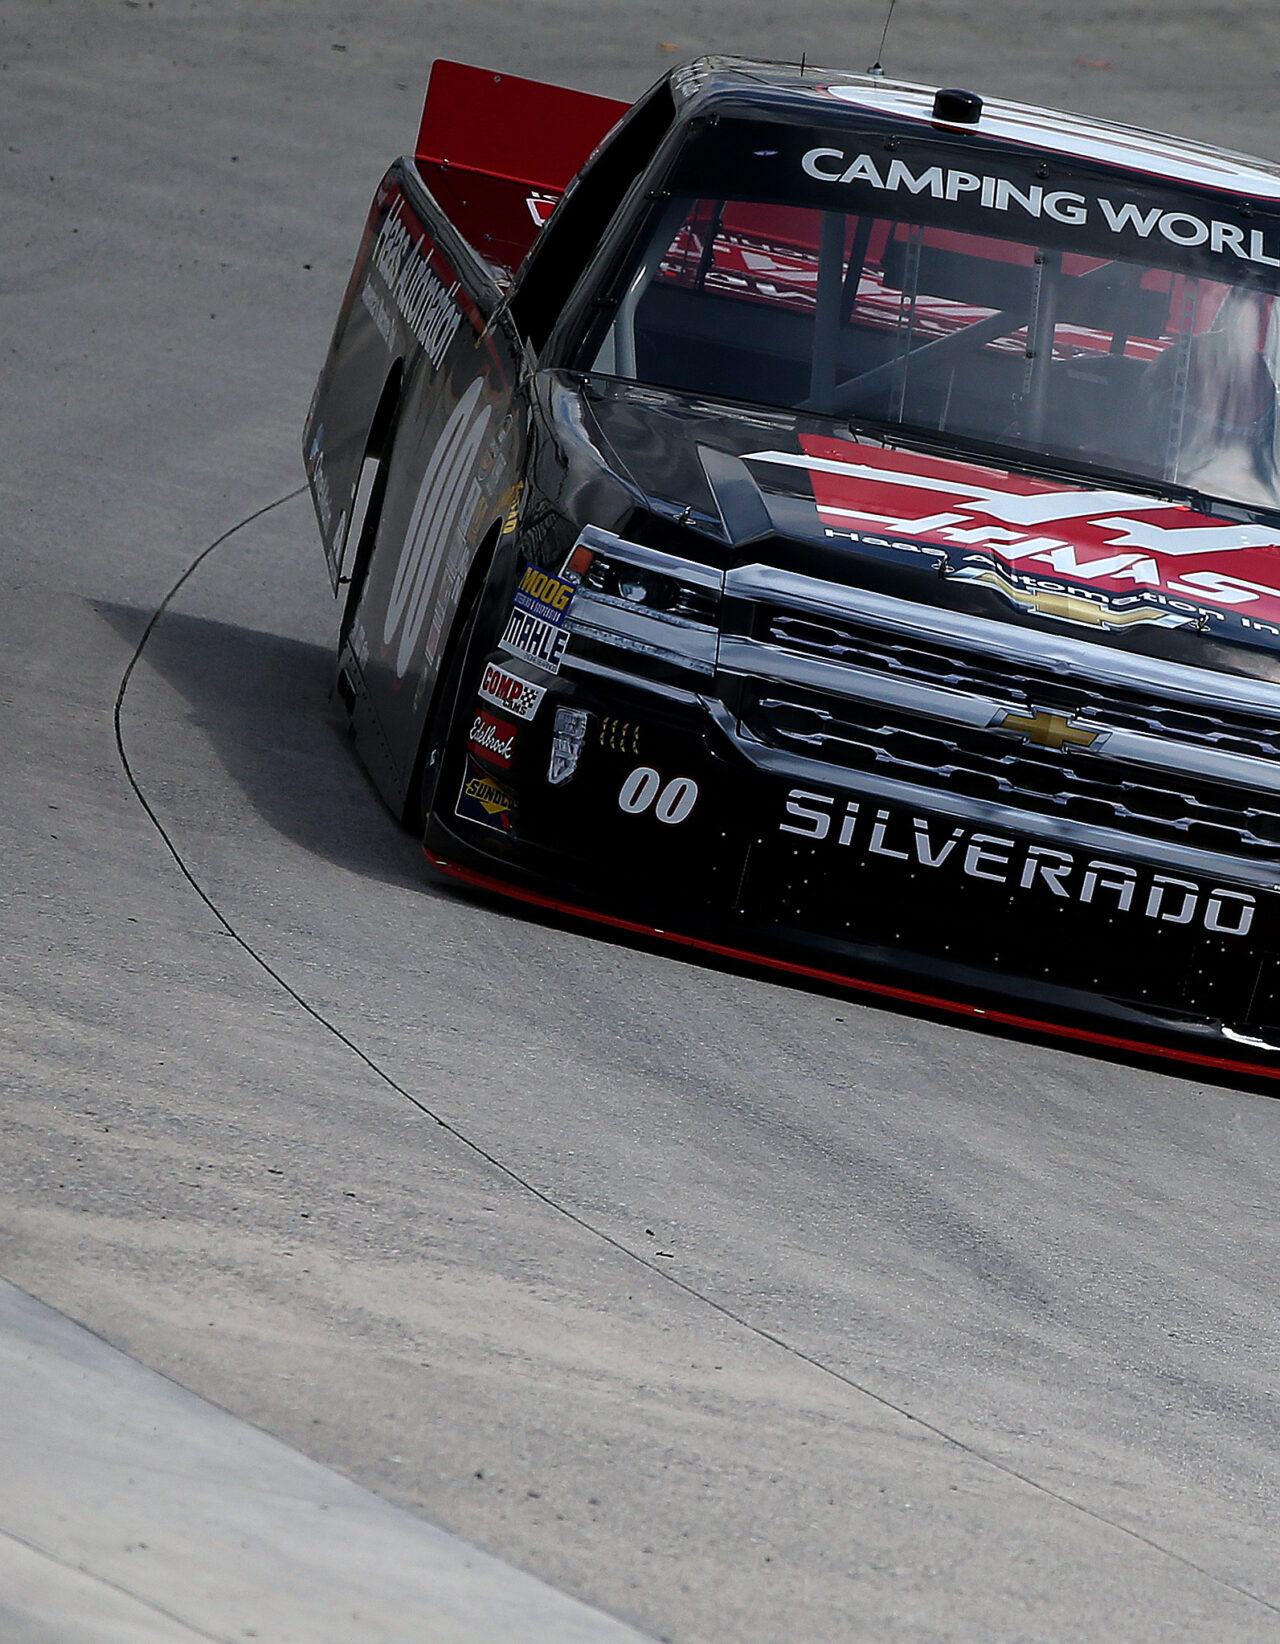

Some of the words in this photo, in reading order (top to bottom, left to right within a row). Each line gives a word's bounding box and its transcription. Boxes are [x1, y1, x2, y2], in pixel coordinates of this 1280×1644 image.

[800, 146, 1088, 226] CAMPING
[372, 193, 411, 290] Haas
[392, 233, 463, 372] Automation
[383, 375, 491, 679] 00
[519, 566, 574, 610] MOOG
[823, 528, 949, 560] Haas
[962, 554, 1225, 622] Automation
[502, 609, 569, 666] MAHLE
[482, 666, 524, 702] COMP
[502, 698, 528, 716] CAMS
[469, 716, 515, 760] Edelbrock
[618, 766, 699, 825] 00
[779, 788, 1256, 937] SILVERADO
